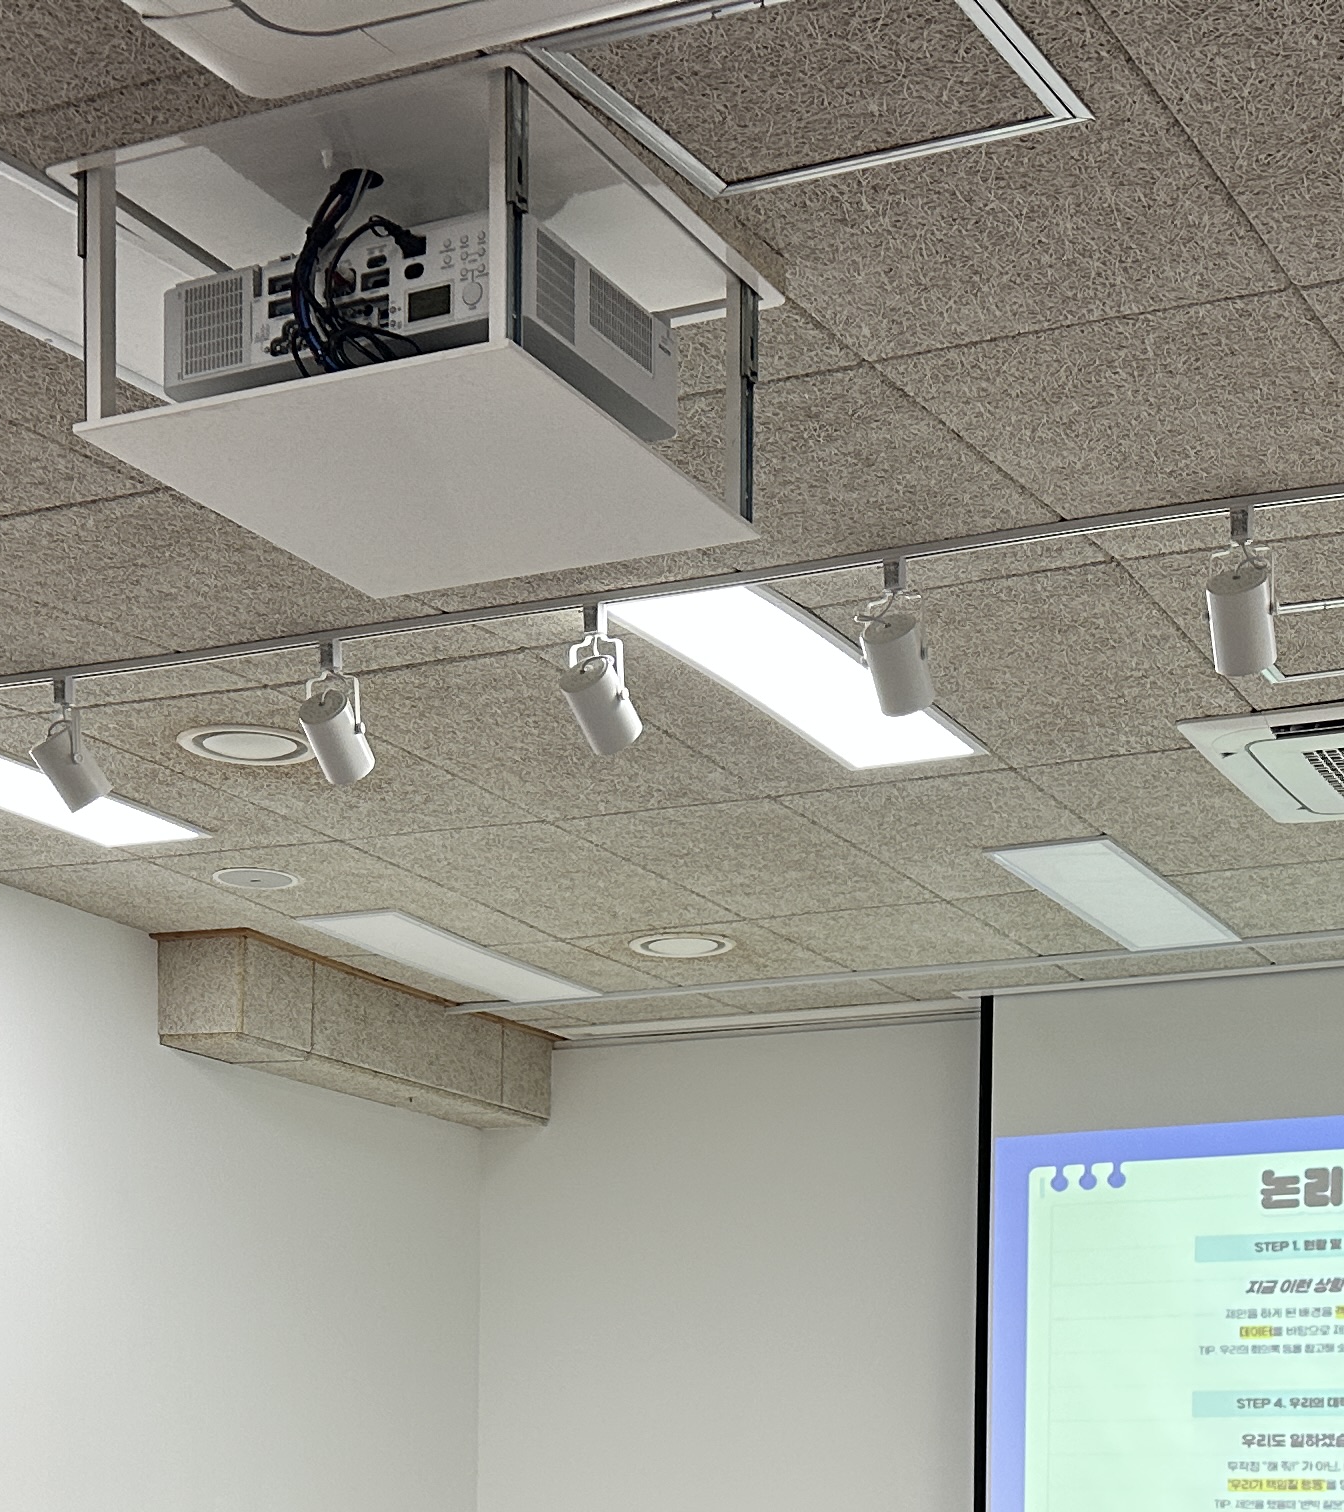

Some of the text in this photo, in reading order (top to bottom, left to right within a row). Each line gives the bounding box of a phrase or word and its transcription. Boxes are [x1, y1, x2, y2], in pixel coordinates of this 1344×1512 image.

[1255, 1241, 1289, 1253] STEP
[1292, 1240, 1301, 1251] 1.
[1245, 1279, 1279, 1294] 지금
[1280, 1278, 1314, 1293] 이런
[1225, 1308, 1258, 1319] 제안을
[1261, 1307, 1283, 1318] 하게
[1285, 1306, 1296, 1318] 된
[1299, 1306, 1333, 1318] 배경을
[1240, 1326, 1283, 1338] 데이터를
[1286, 1325, 1330, 1336] 바탕으로
[1220, 1344, 1249, 1355] 우리의
[1237, 1398, 1271, 1409] STEP
[1273, 1398, 1286, 1409] 4.
[1289, 1397, 1325, 1408] 우리의
[1241, 1433, 1286, 1448] 우리도
[1227, 1461, 1260, 1472] 무작정
[1302, 1460, 1313, 1471] 가
